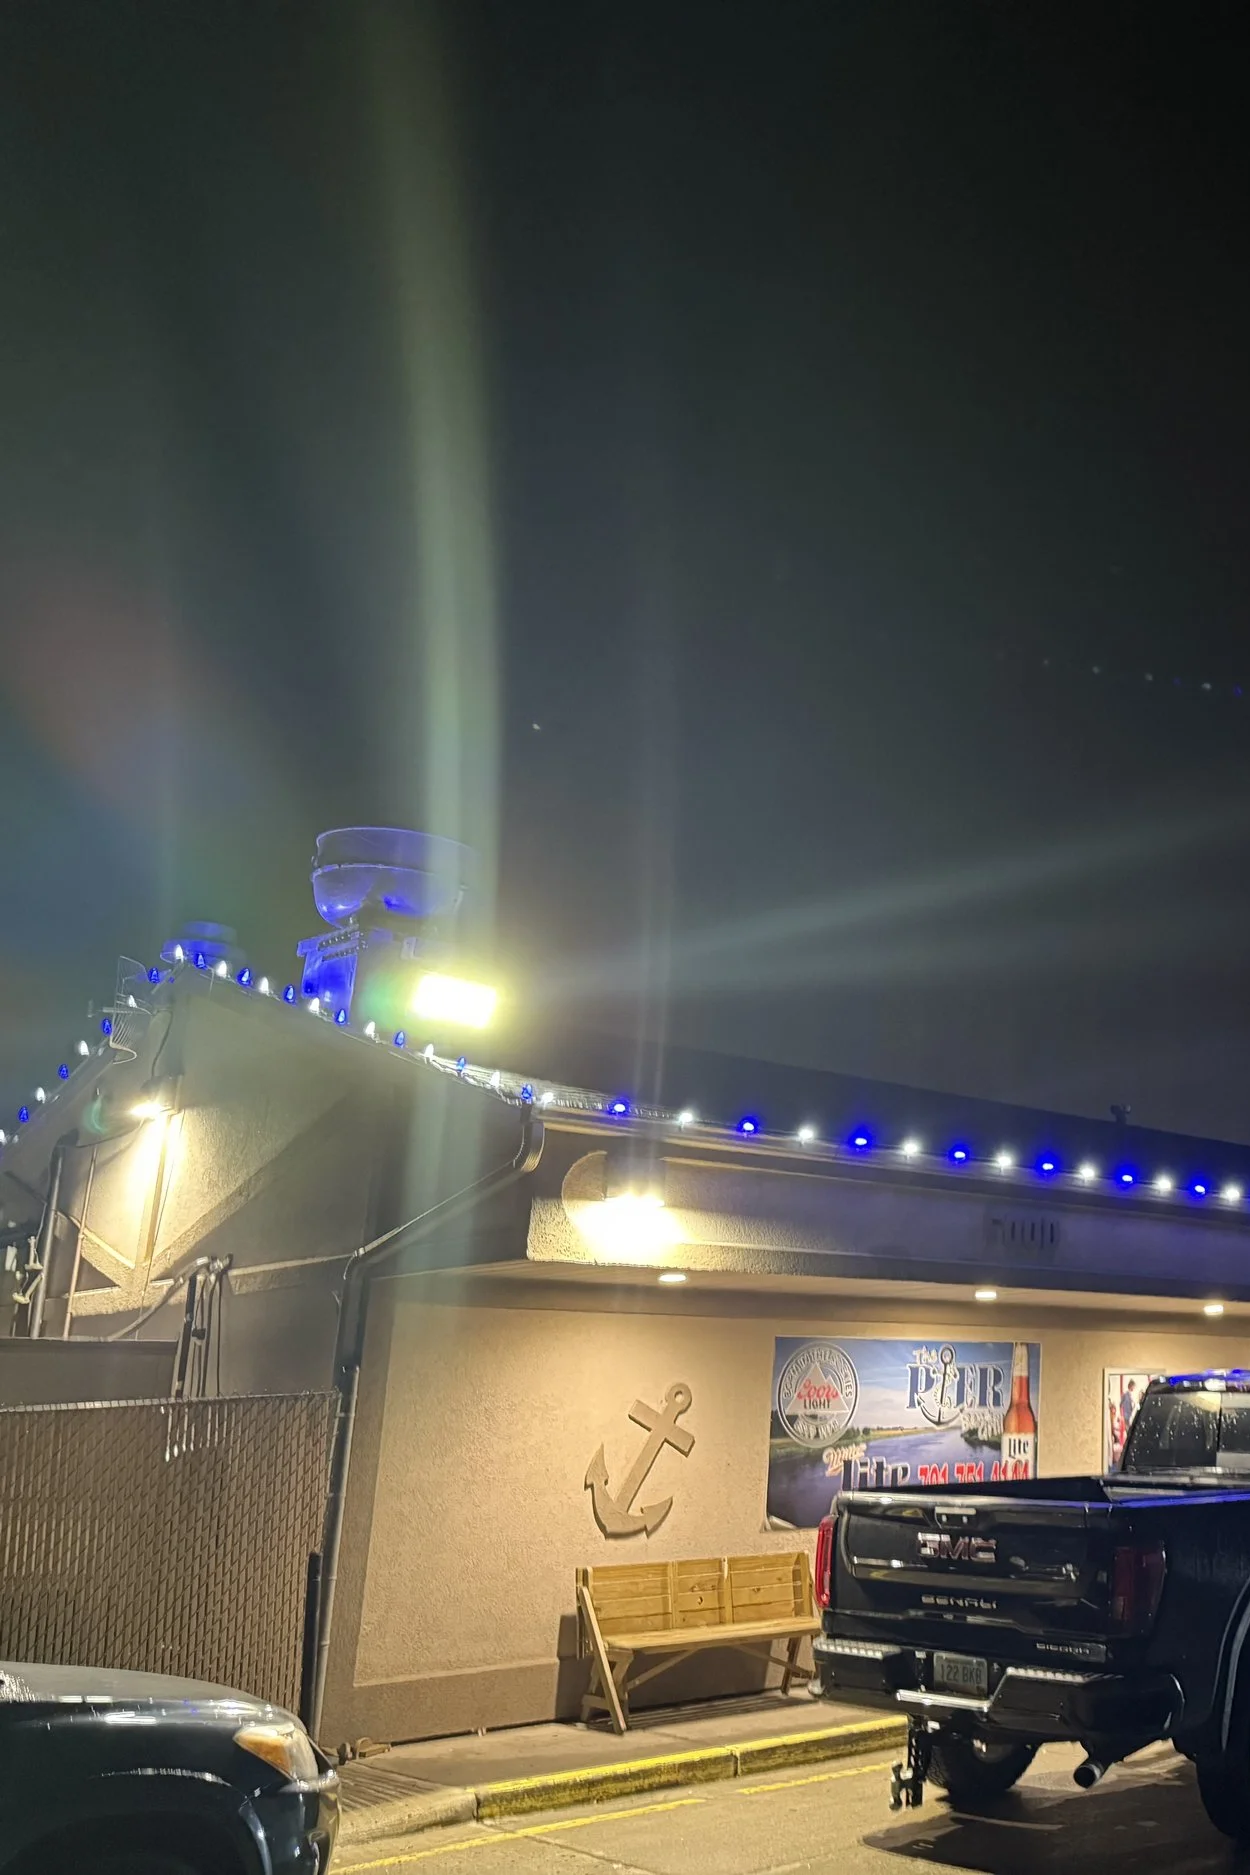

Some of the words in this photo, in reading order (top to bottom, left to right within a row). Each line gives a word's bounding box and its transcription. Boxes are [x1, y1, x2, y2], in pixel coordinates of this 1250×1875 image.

[906, 1363, 1005, 1410] PIER
[803, 1398, 830, 1410] LIGHT
[917, 1532, 997, 1563] GMC
[921, 1595, 997, 1609] DENALI
